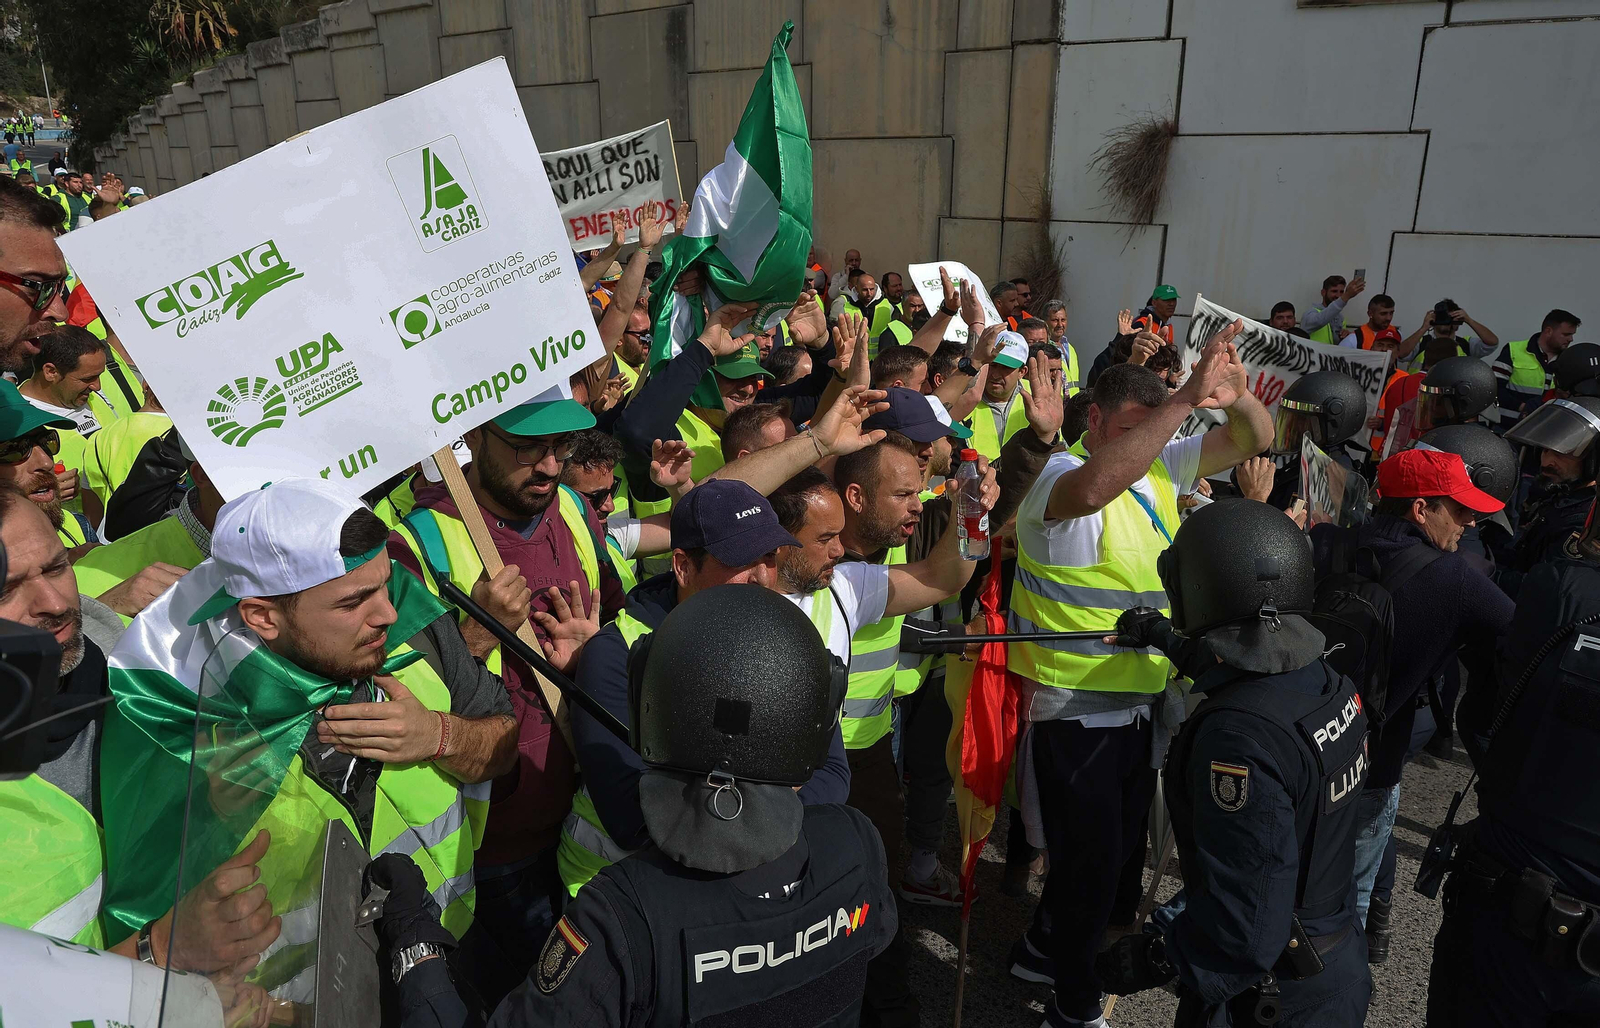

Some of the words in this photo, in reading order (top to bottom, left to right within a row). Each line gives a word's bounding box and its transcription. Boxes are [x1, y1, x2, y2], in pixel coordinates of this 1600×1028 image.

[543, 152, 593, 181] AQUI
[600, 133, 649, 165] QUE
[573, 167, 614, 200] ALLI
[618, 154, 660, 190] SON
[421, 204, 478, 238] ASAJA
[441, 217, 482, 242] CADIZ
[142, 242, 281, 324] COAG
[430, 251, 525, 302] cooperativas
[436, 250, 558, 316] agro-alimentarias
[176, 307, 221, 339] Cádiz
[444, 301, 491, 329] Andalucía
[275, 331, 344, 378] UPA
[431, 362, 527, 424] Campo
[529, 328, 587, 373] Vivo
[287, 382, 310, 396] Unión
[310, 377, 320, 386] de
[320, 359, 354, 380] Pequeños
[292, 365, 357, 405] AGRICULTORES
[304, 373, 359, 406] GANADEROS
[76, 419, 96, 433] PUMA
[338, 443, 378, 479] un
[735, 505, 762, 520] Levi's
[1312, 695, 1360, 752] POLICIA
[1330, 753, 1367, 803] U.I.P.
[694, 907, 852, 984] POLICIA
